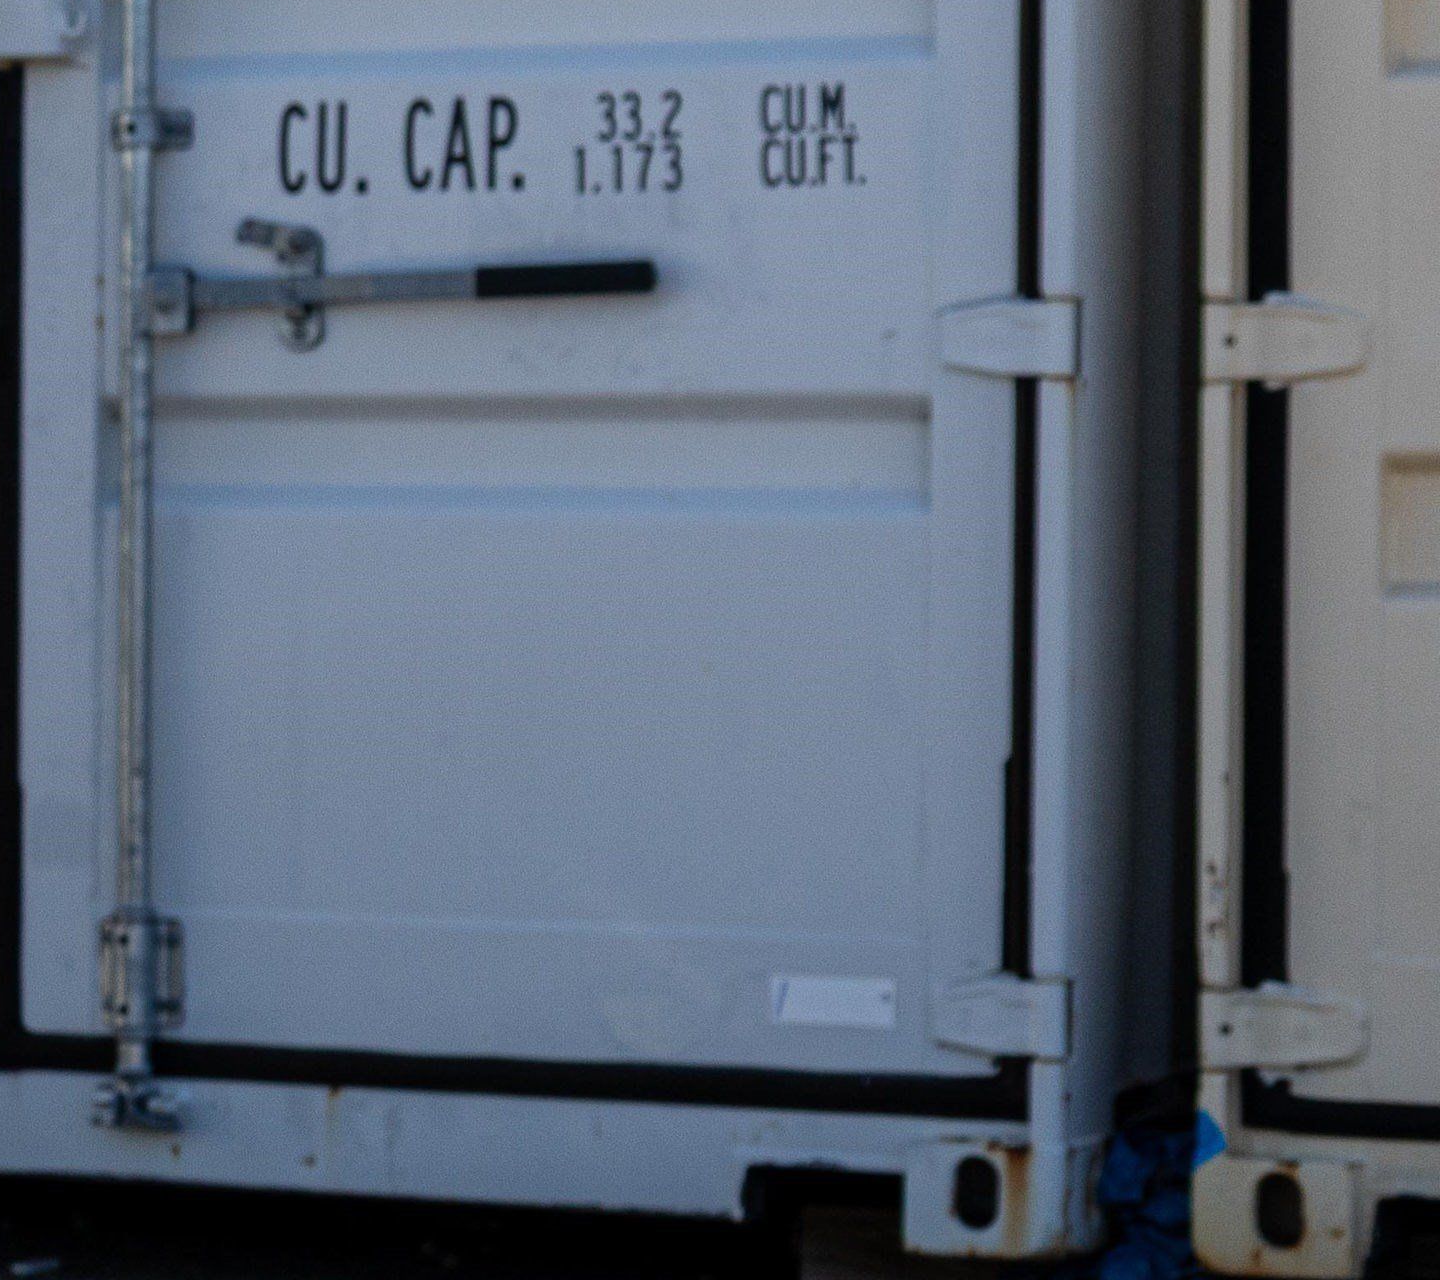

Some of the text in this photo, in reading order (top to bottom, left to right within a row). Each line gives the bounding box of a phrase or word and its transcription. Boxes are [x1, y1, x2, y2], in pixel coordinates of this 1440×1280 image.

[276, 100, 370, 196] CU.
[402, 94, 526, 193] CAP.
[596, 89, 683, 142] 33.2
[574, 141, 683, 194] 1.173
